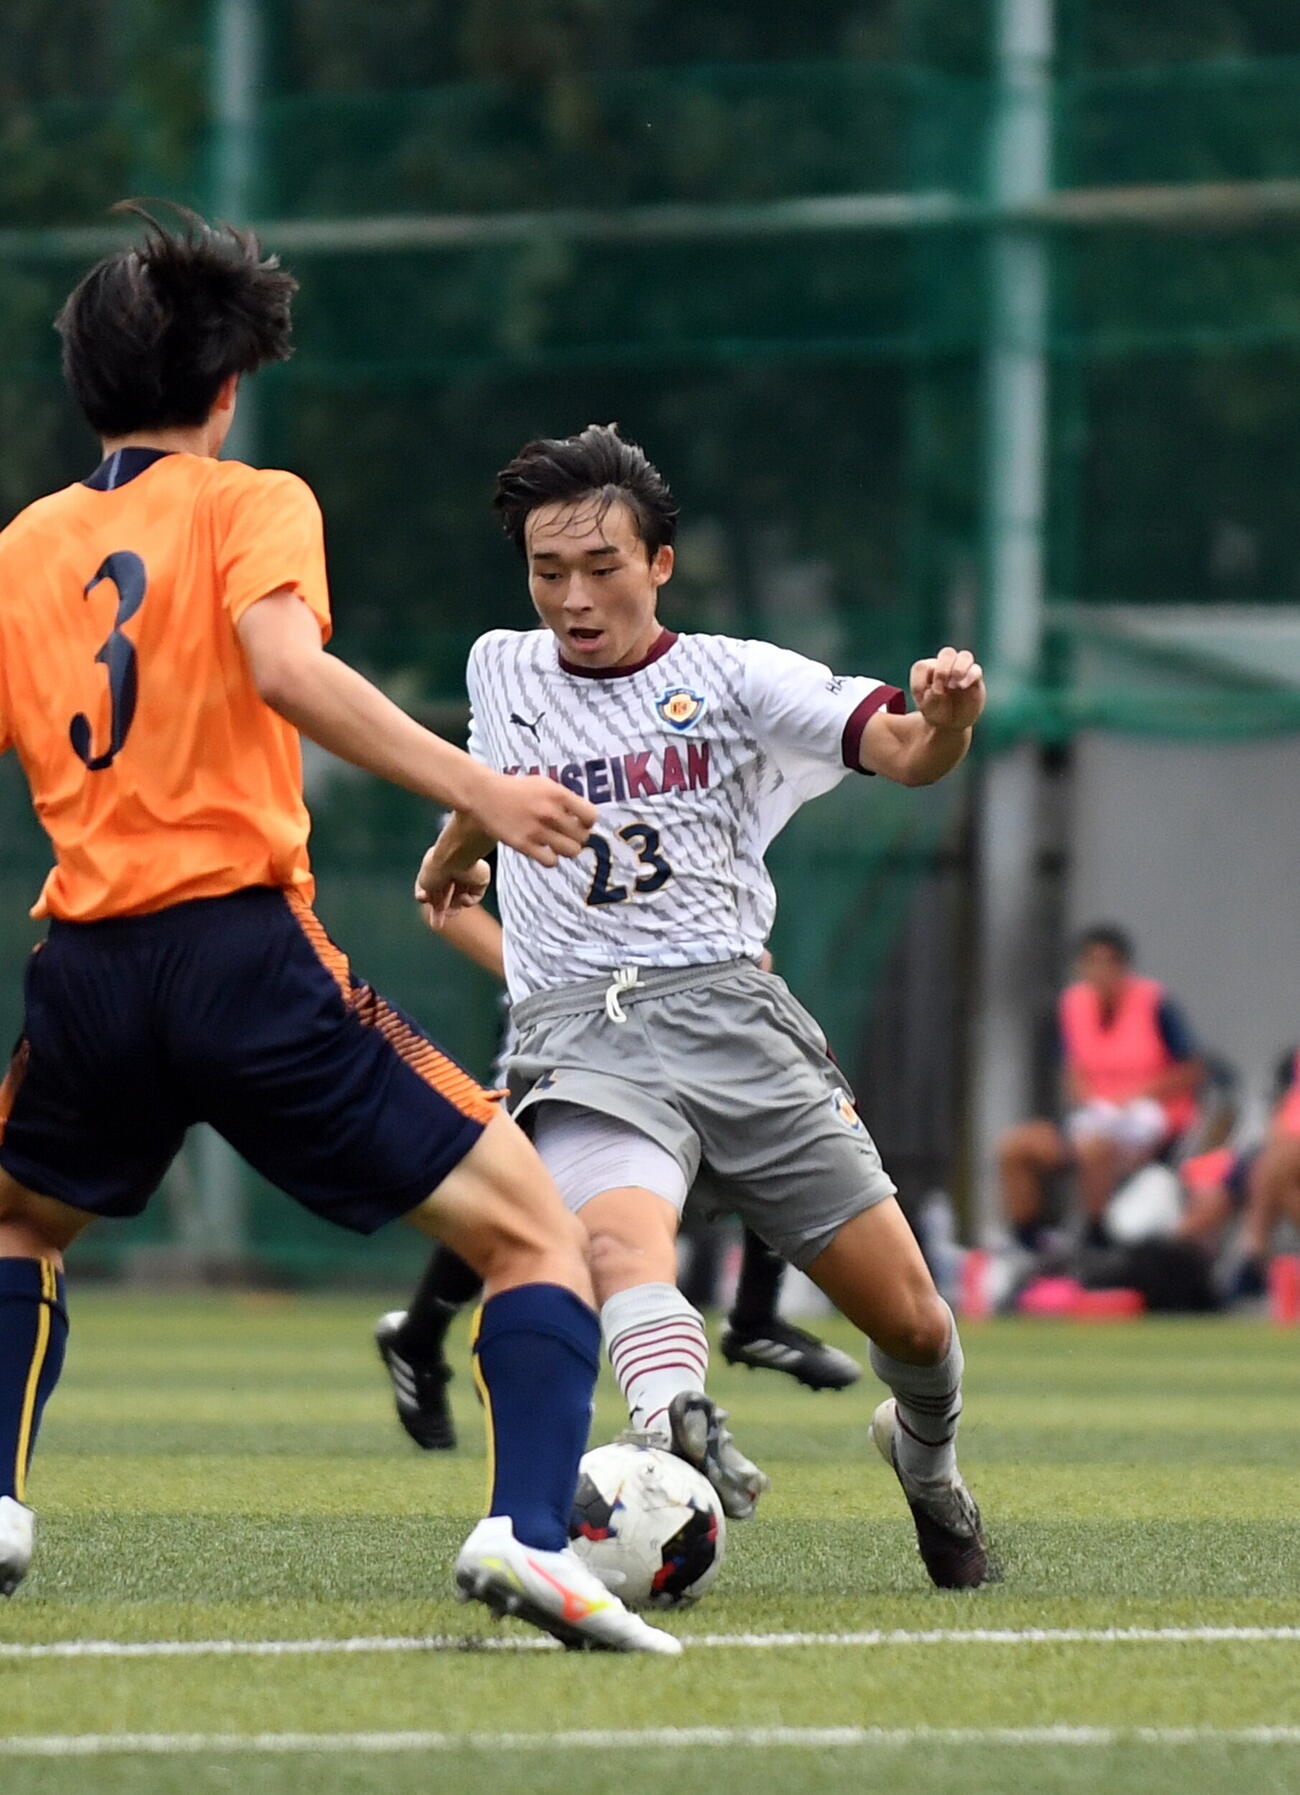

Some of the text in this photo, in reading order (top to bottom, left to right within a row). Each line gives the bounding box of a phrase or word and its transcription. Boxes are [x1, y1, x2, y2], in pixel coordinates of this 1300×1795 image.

[69, 550, 147, 771] 3
[503, 741, 710, 805] SEIKAN
[581, 823, 673, 906] 23
